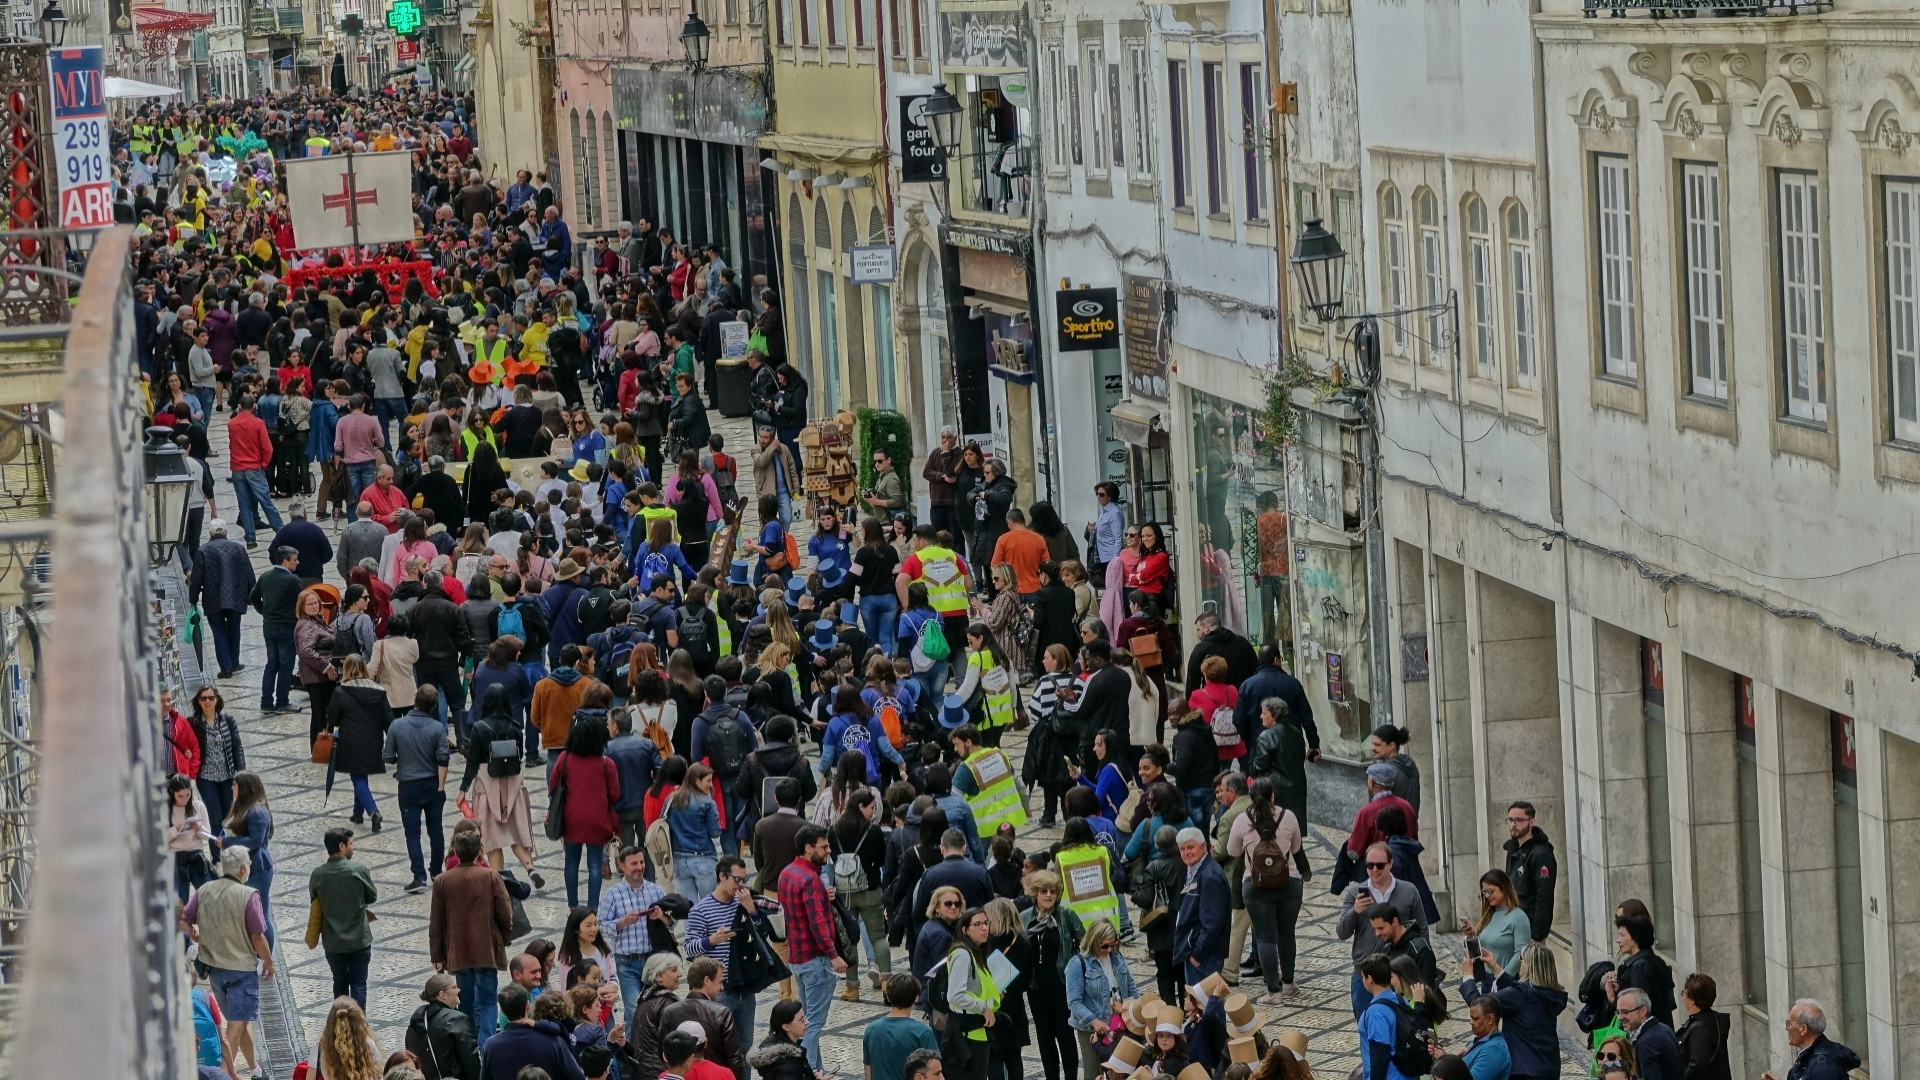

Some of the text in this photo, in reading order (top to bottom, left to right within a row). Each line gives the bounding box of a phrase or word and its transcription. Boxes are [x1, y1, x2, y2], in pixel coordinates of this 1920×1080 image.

[64, 120, 100, 150] 239
[906, 129, 931, 142] gan
[909, 145, 936, 157] four
[67, 154, 102, 183] 919
[856, 259, 890, 268] PORTUGUESE
[1063, 316, 1115, 338] Sportino
